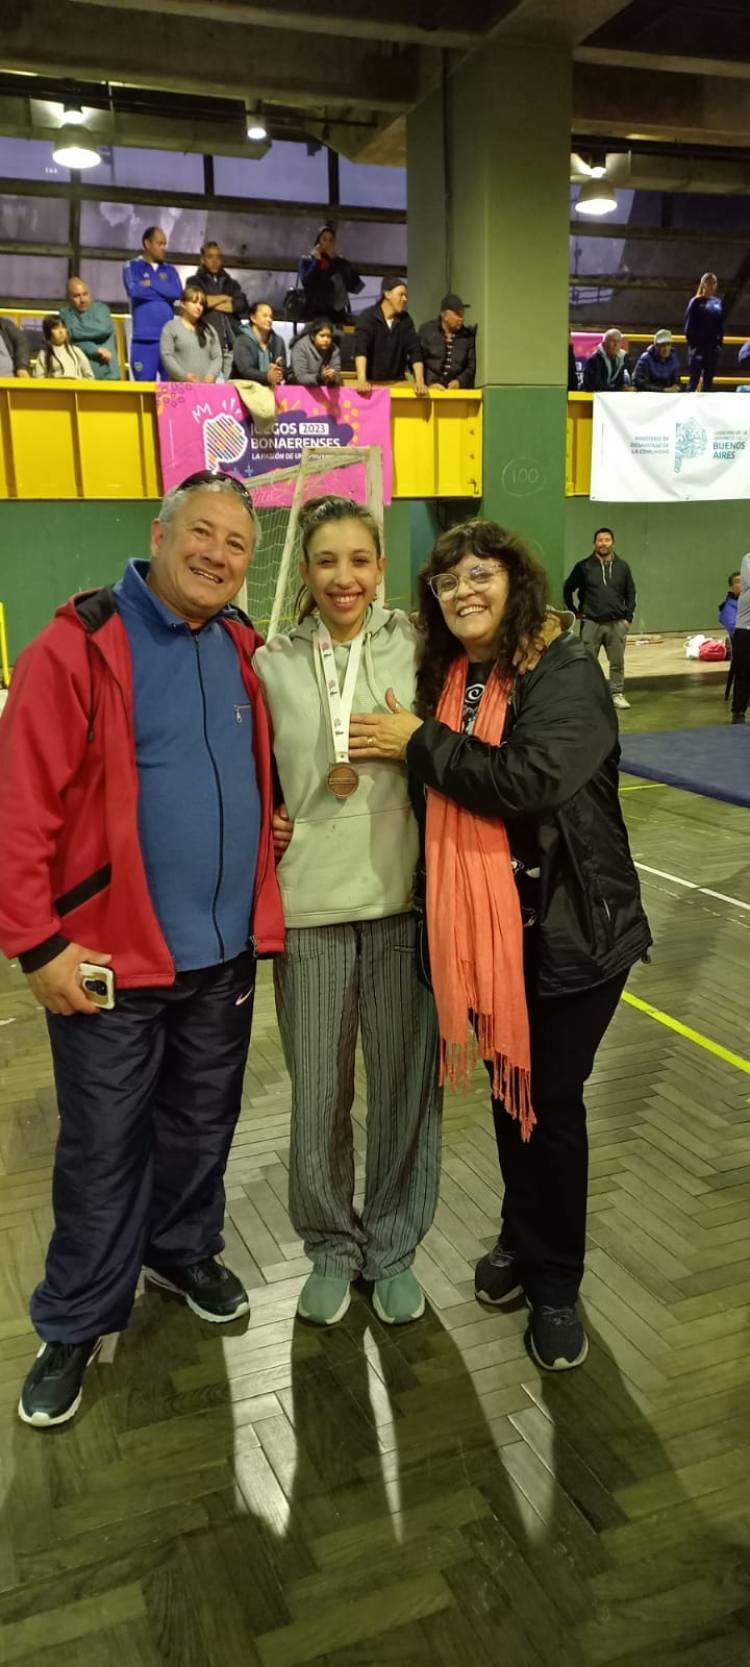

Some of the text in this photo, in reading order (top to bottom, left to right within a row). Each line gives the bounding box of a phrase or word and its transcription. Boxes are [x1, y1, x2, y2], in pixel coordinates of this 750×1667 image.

[251, 423, 326, 435] JUGOS 2023
[251, 437, 340, 449] BONAERENSES
[713, 441, 746, 450] BUENOS
[713, 450, 736, 459] AIRES
[511, 468, 540, 484] 100
